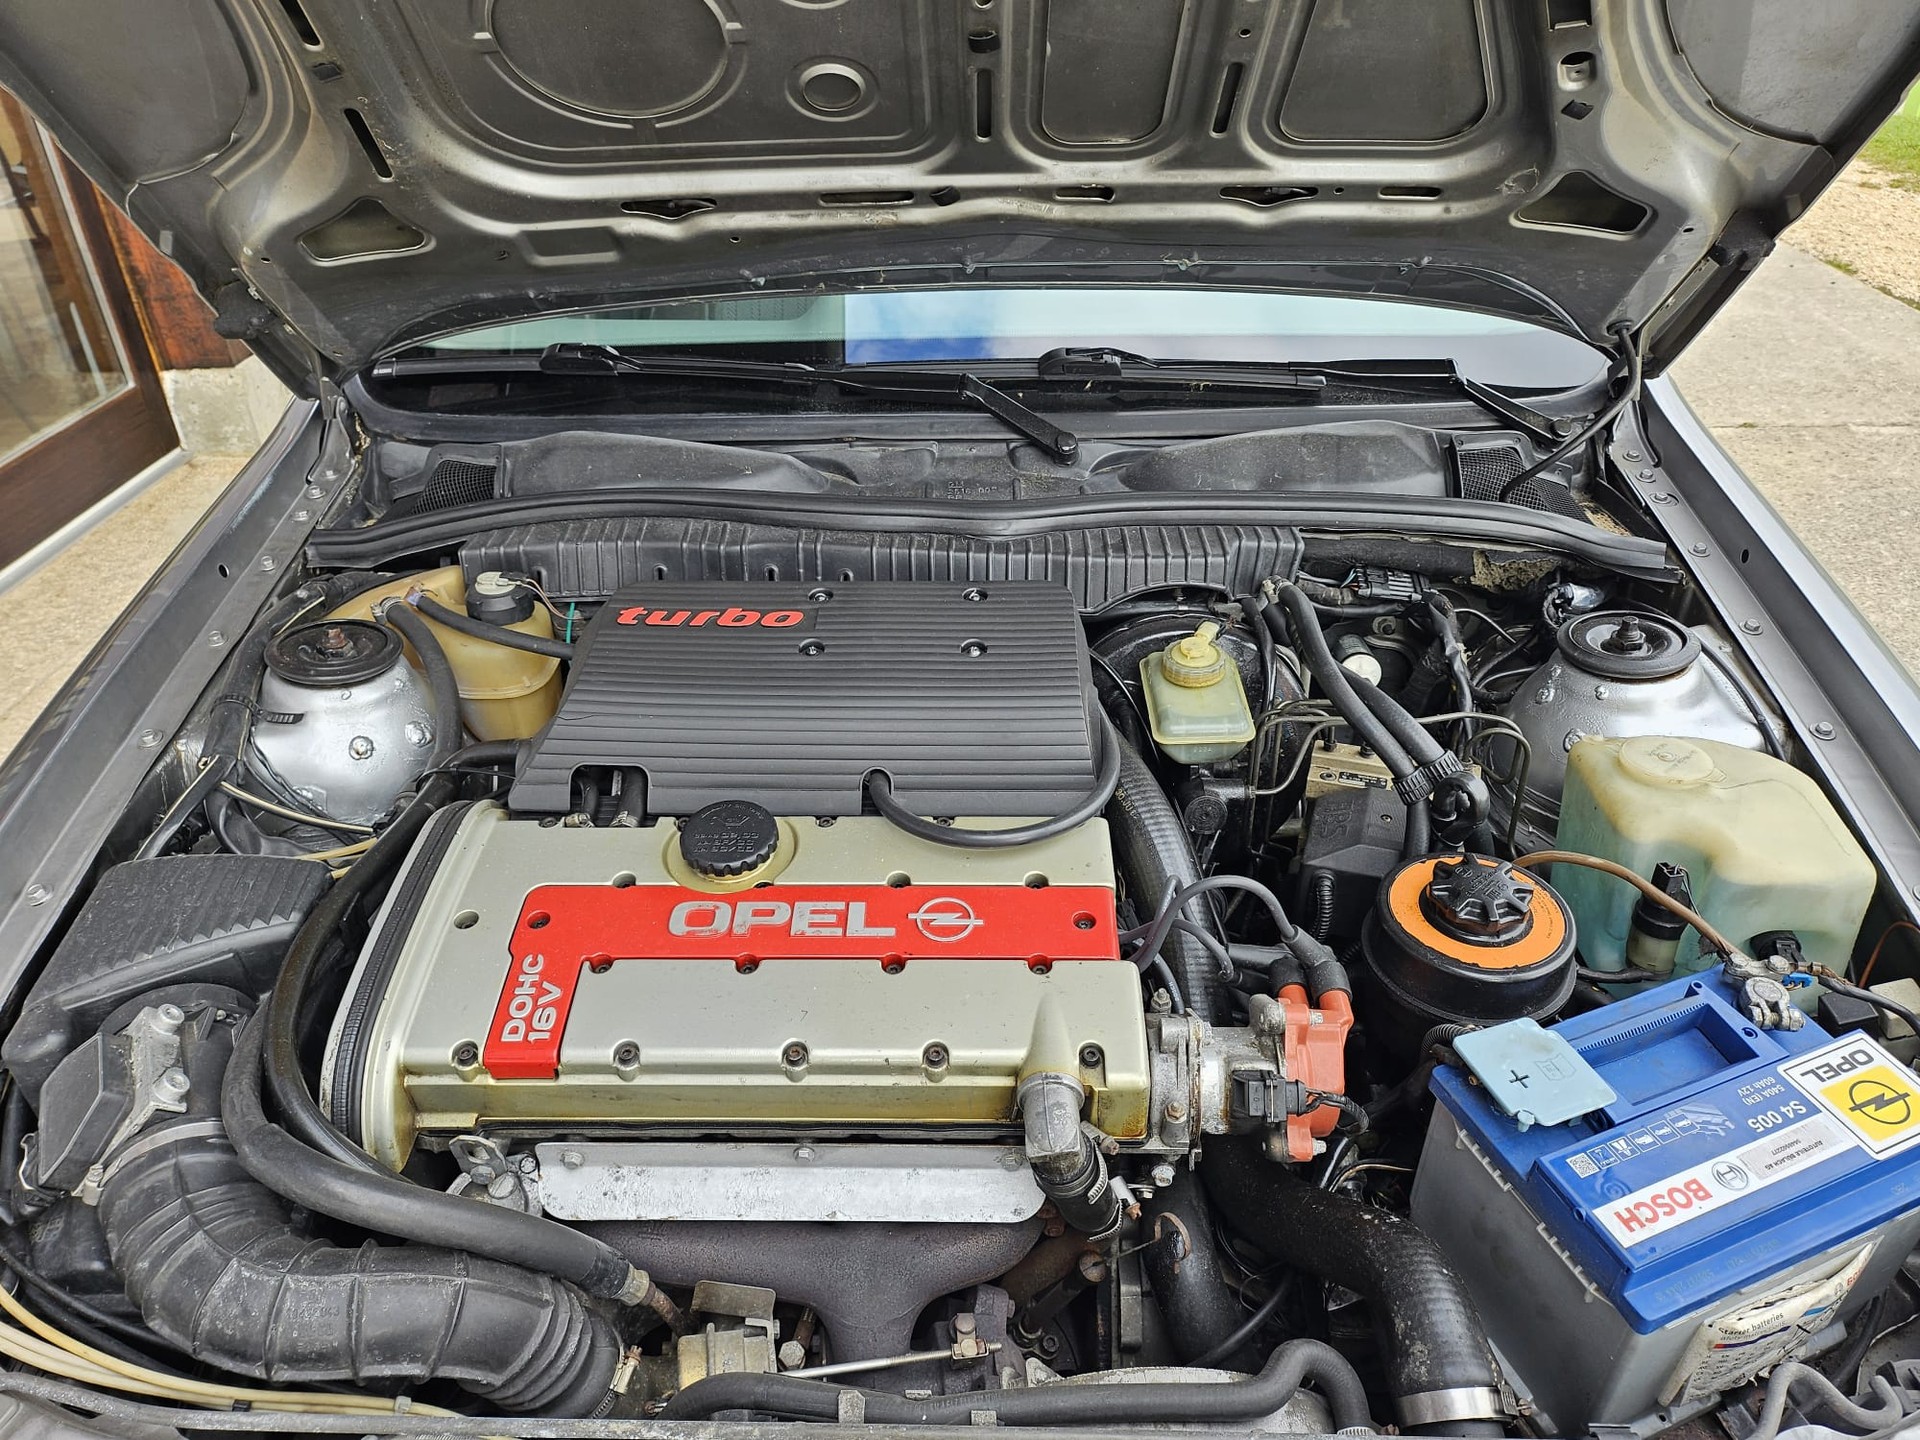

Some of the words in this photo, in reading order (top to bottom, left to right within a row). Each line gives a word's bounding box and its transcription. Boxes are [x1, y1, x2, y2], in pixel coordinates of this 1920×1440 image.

[617, 607, 804, 627] turbo
[668, 902, 895, 938] OPEL
[502, 954, 544, 1042] DOHC
[527, 981, 562, 1043] 16V
[1801, 1049, 1874, 1084] OPEL
[1737, 1084, 1753, 1097] 12V
[1753, 1076, 1775, 1088] 60Ah
[1742, 1093, 1761, 1106] (EN)
[1780, 1101, 1807, 1118] S4
[1748, 1111, 1782, 1132] 005
[1615, 1178, 1712, 1233] BOSCH
[1752, 1313, 1783, 1331] batteries
